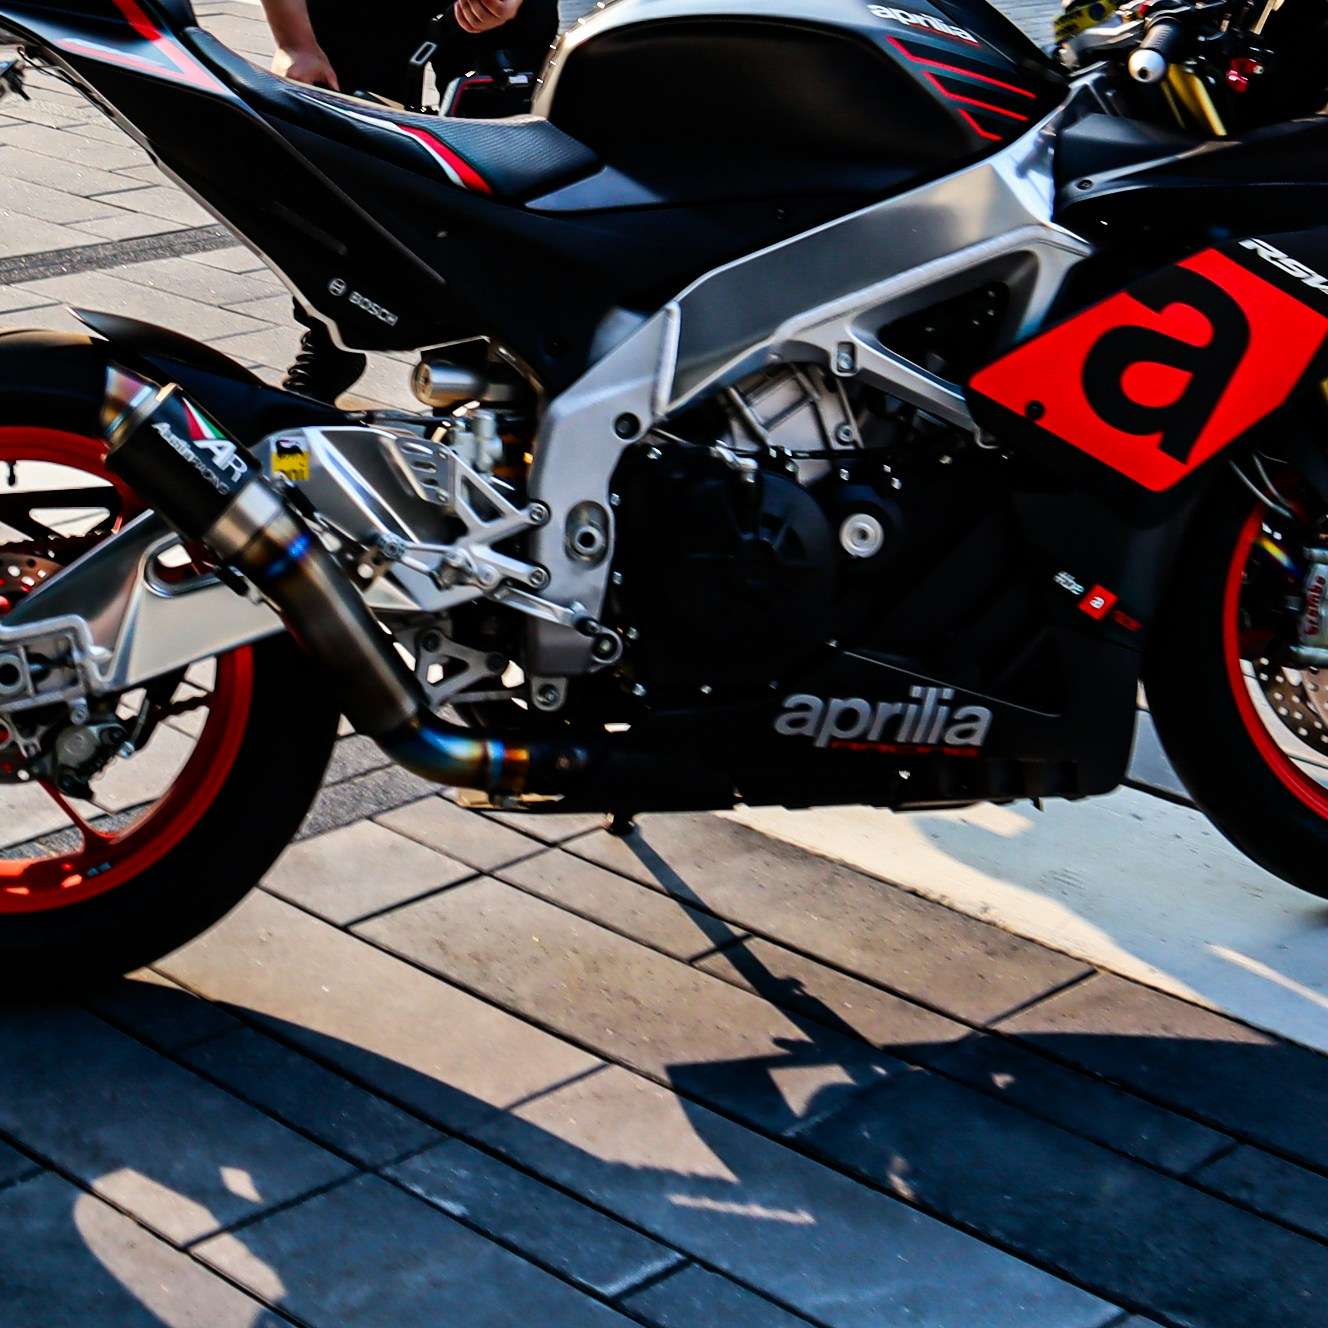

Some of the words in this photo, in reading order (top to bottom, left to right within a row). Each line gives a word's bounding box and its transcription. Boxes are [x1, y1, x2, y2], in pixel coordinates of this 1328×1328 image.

[867, 3, 978, 44] aprilia
[348, 290, 399, 327] BOSCH
[774, 685, 994, 749] aprilia
